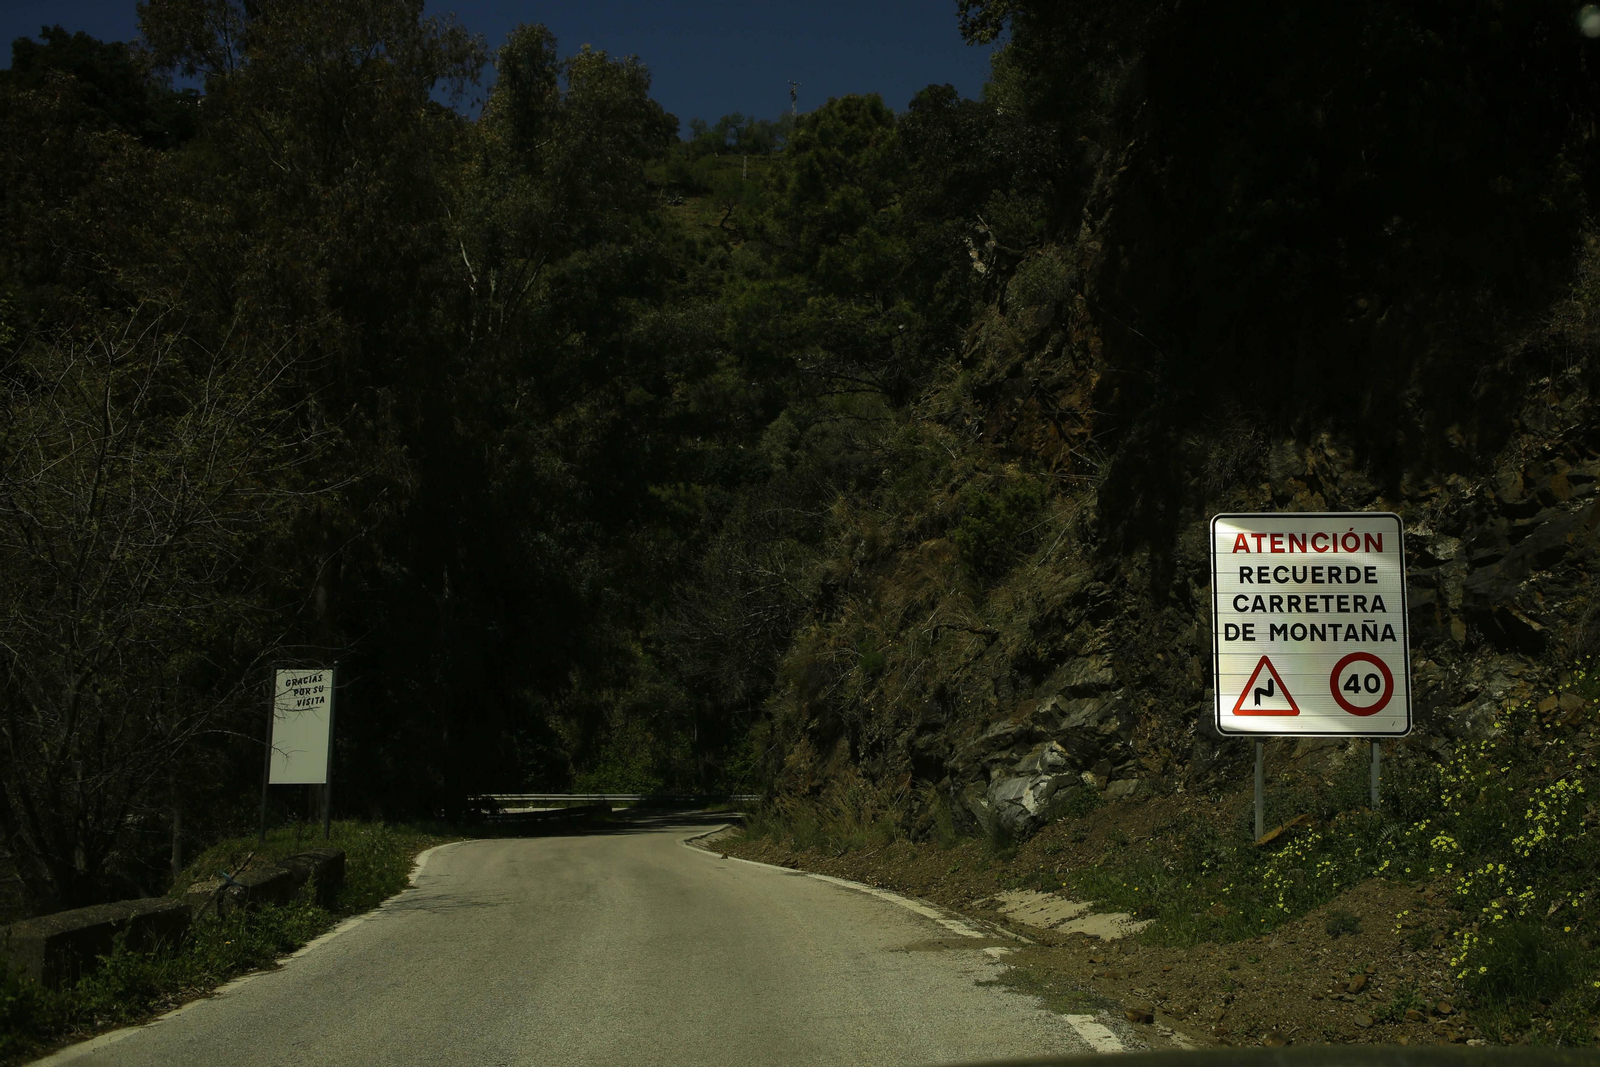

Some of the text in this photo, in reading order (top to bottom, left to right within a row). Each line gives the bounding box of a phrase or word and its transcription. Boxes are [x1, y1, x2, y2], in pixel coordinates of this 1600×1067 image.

[1232, 527, 1383, 554] ATENCIÓN
[1239, 565, 1378, 584] RECUERDE
[1232, 594, 1387, 613] CARRETERA
[1224, 619, 1398, 642] DE MONTAÑA
[285, 674, 323, 687] GRACIAS
[1343, 673, 1381, 694] 40
[293, 685, 324, 696] POR SU
[296, 696, 325, 707] VISITA
